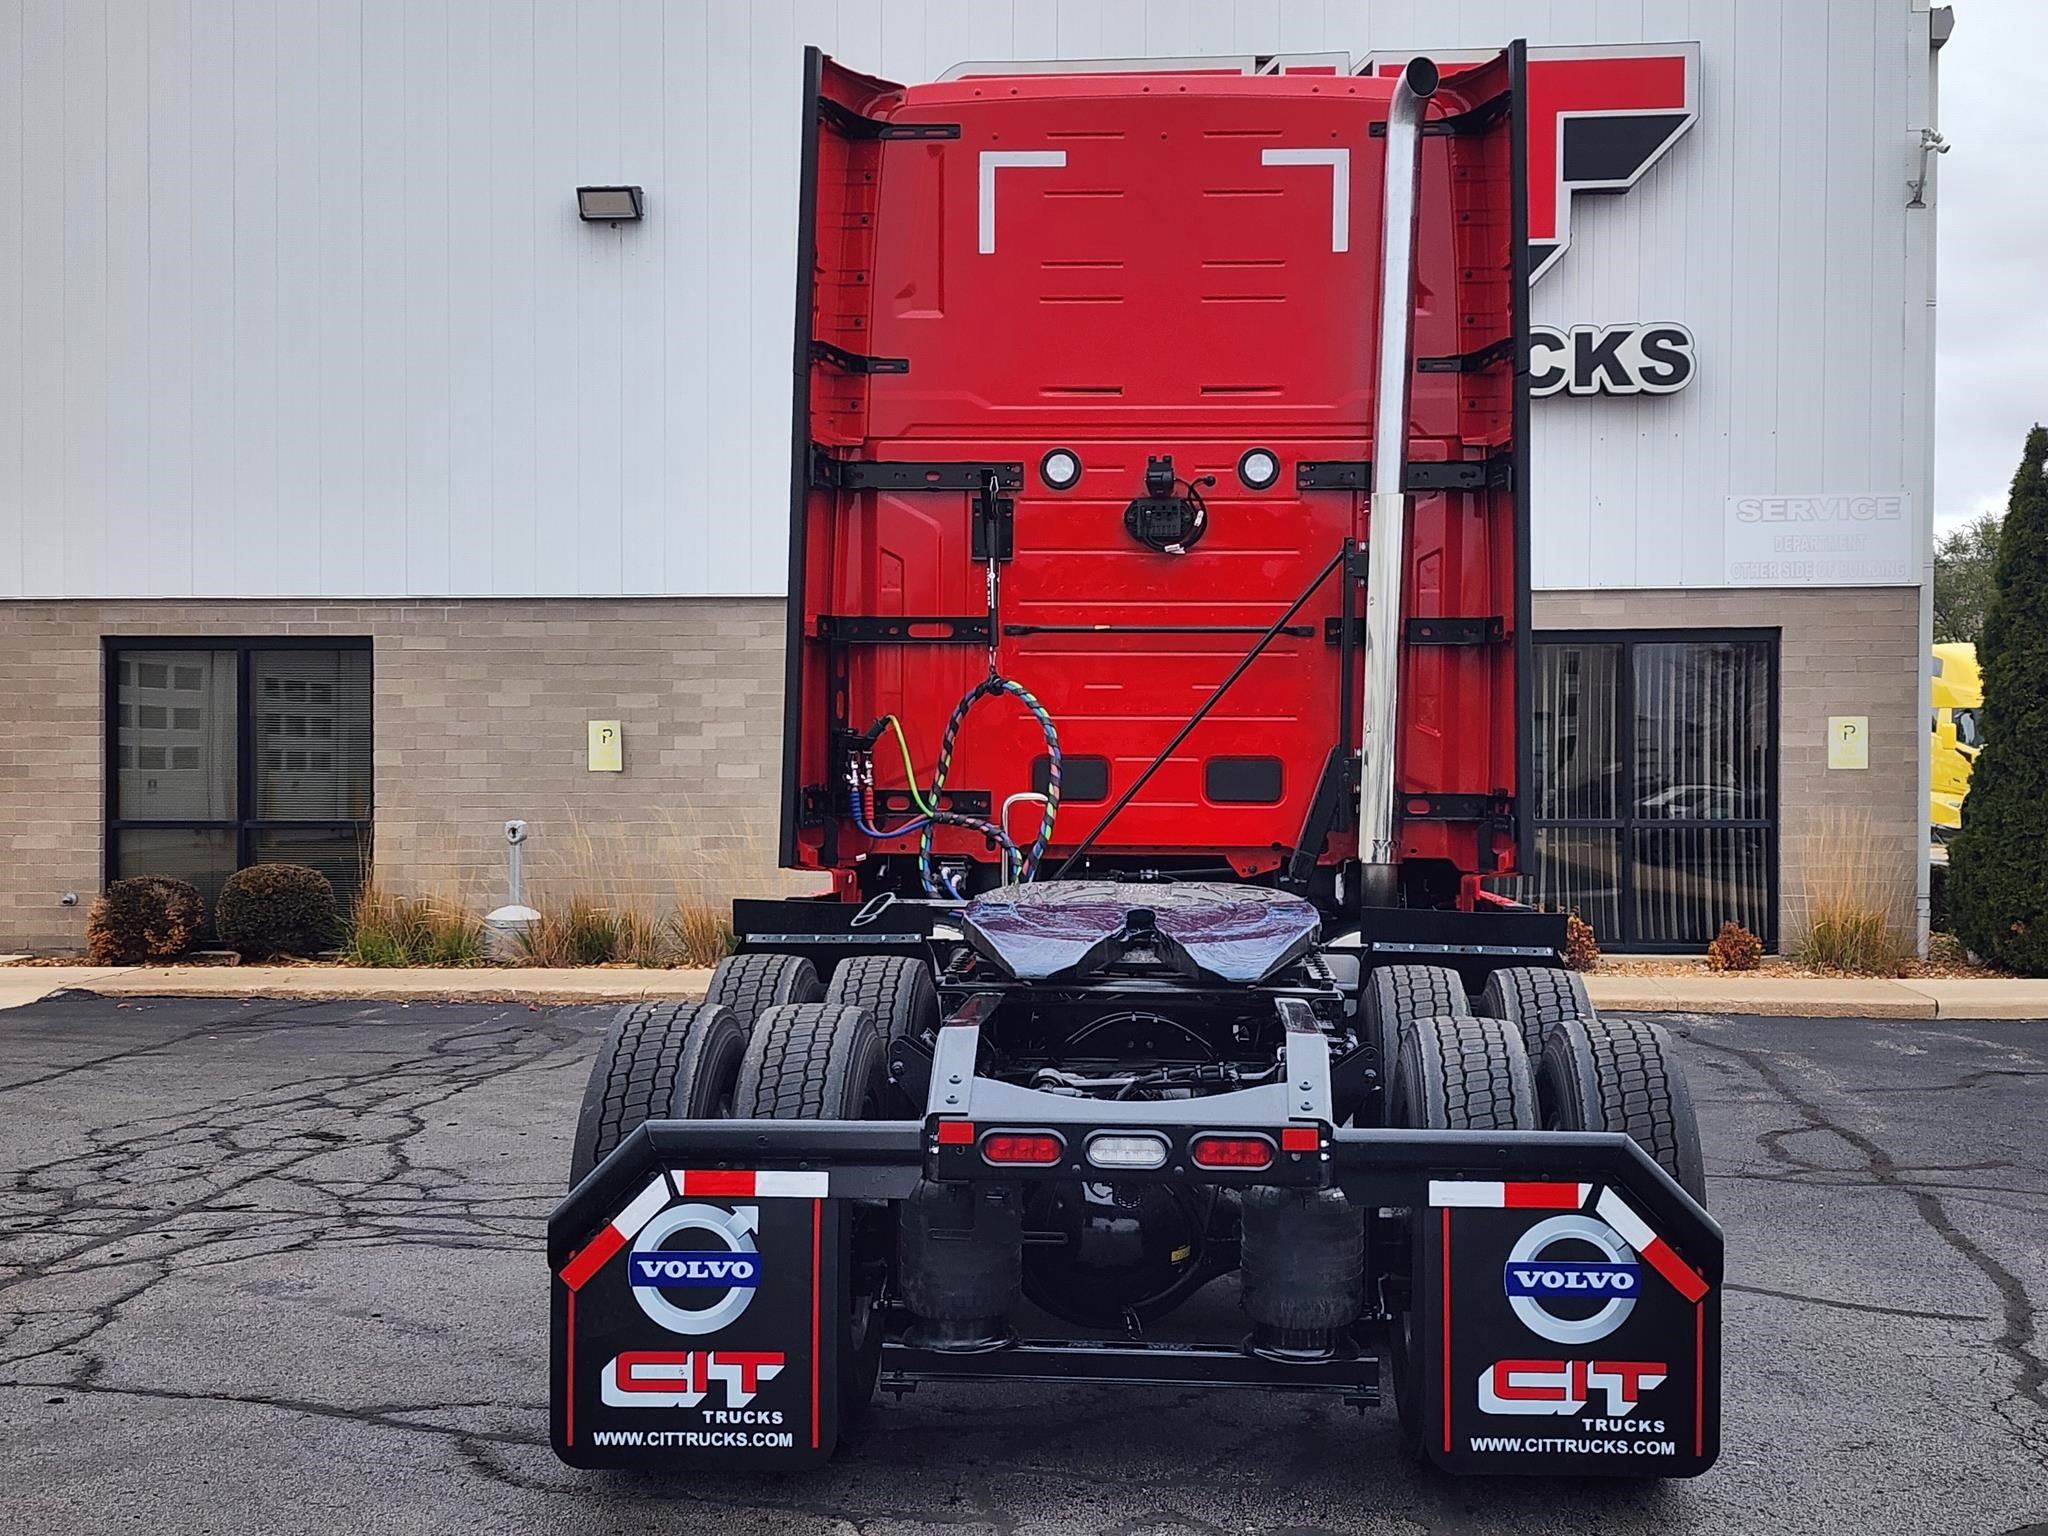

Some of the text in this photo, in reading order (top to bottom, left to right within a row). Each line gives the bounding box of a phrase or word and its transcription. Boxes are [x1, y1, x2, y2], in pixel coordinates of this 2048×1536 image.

[1530, 329, 1691, 389] CKS
[1736, 496, 1901, 522] SERVICE
[1730, 562, 1778, 579] OTHER
[1781, 561, 1813, 578] SIDE
[637, 1260, 754, 1279] VOLVO
[1513, 1271, 1634, 1290] VOLVO
[601, 1350, 785, 1408] CIT
[1478, 1359, 1667, 1417] CIT
[702, 1410, 784, 1425] TRUCKS
[1581, 1418, 1665, 1433] TRUCKS
[593, 1431, 793, 1448] WWW.CITTRUCKS.COM
[1470, 1437, 1675, 1456] WWW.CITTRUCKS.COM
